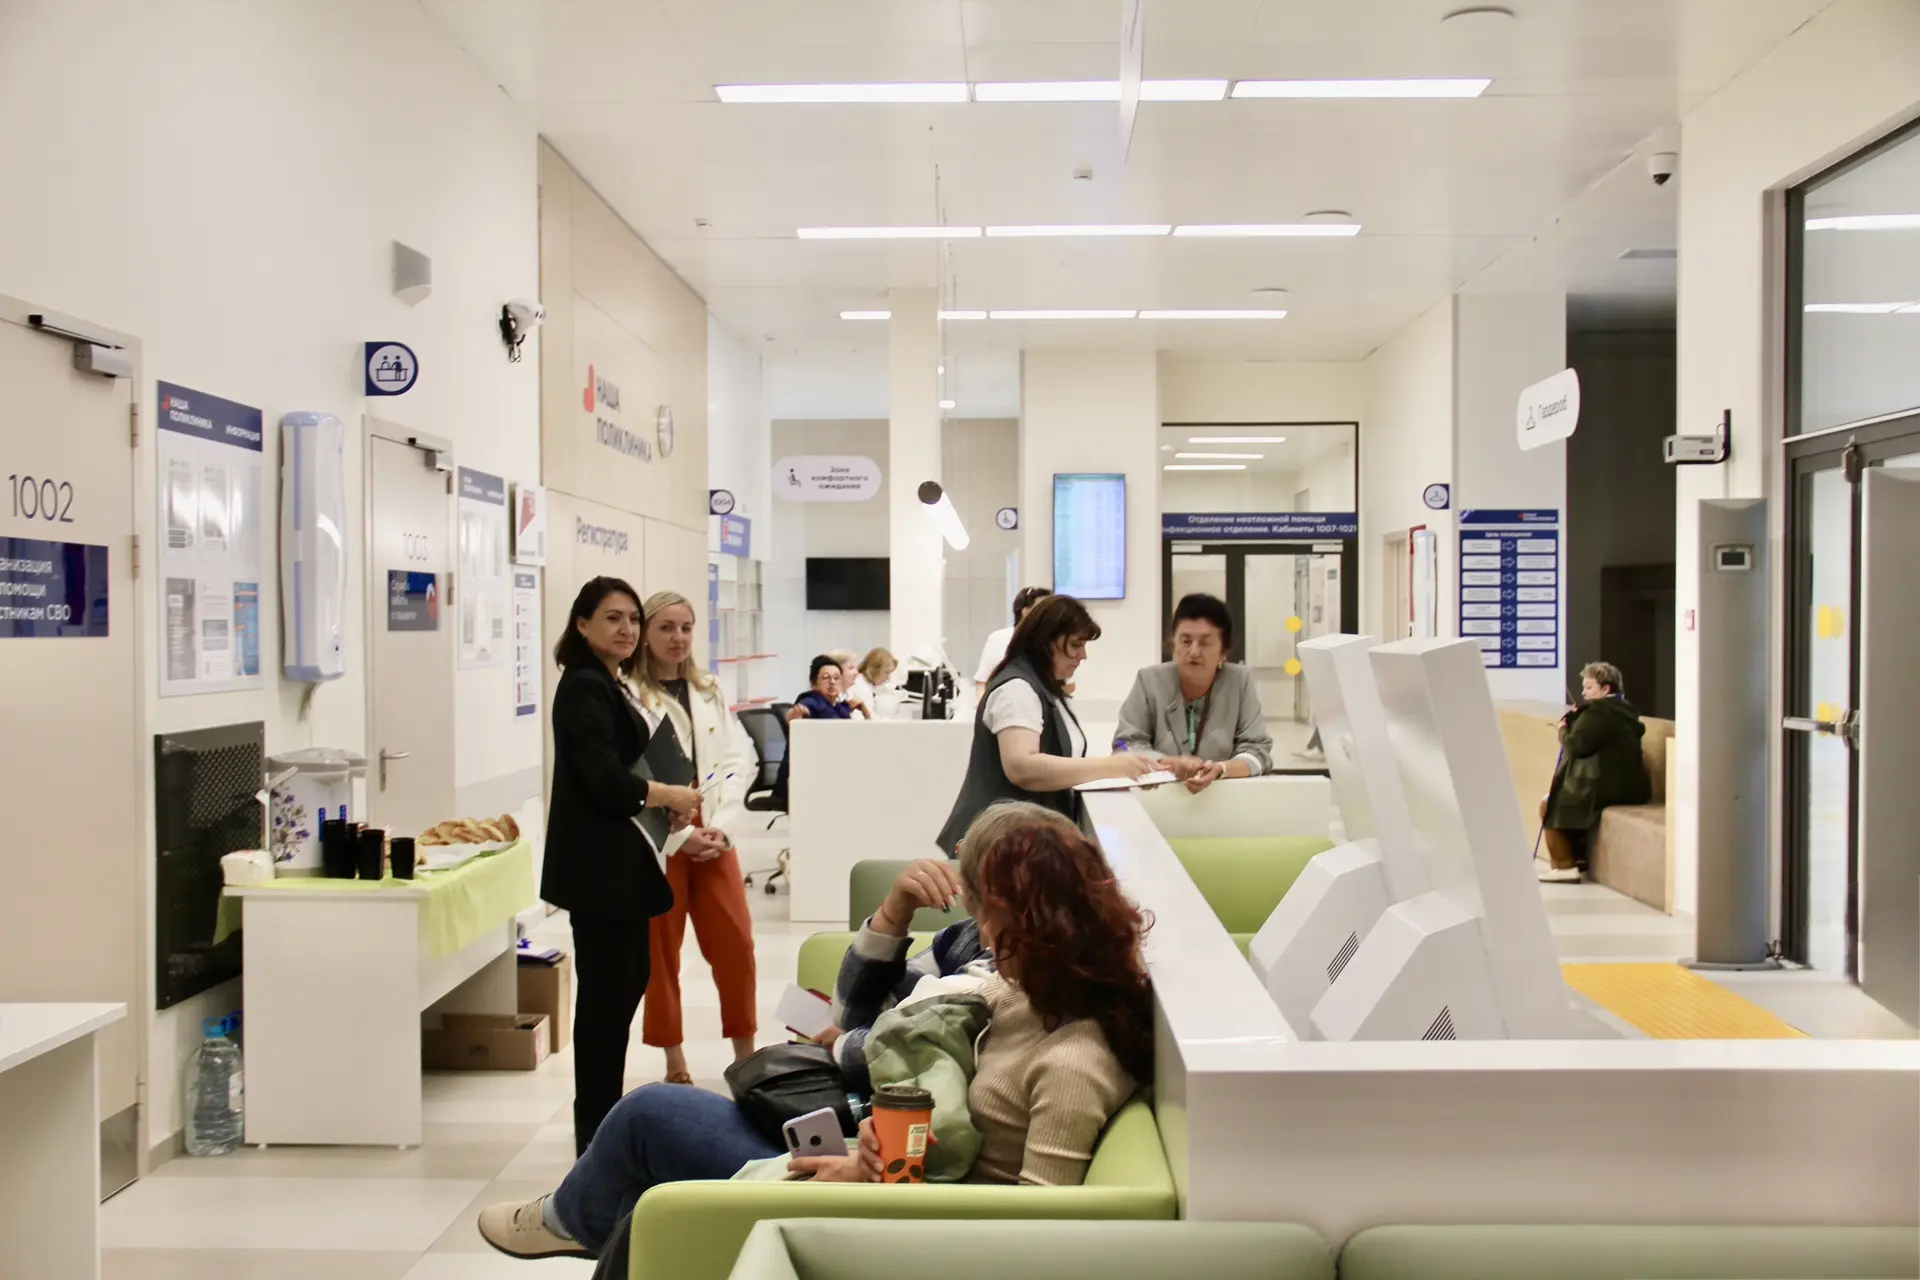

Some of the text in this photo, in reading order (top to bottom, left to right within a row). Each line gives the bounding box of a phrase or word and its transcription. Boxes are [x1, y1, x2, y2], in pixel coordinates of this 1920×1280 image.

[8, 473, 74, 523] 1002
[1187, 514, 1327, 525] Отделение неотложной помощи
[576, 515, 629, 555] Регистратура
[1271, 524, 1315, 534] Кабинеты
[46, 604, 72, 621] СВО
